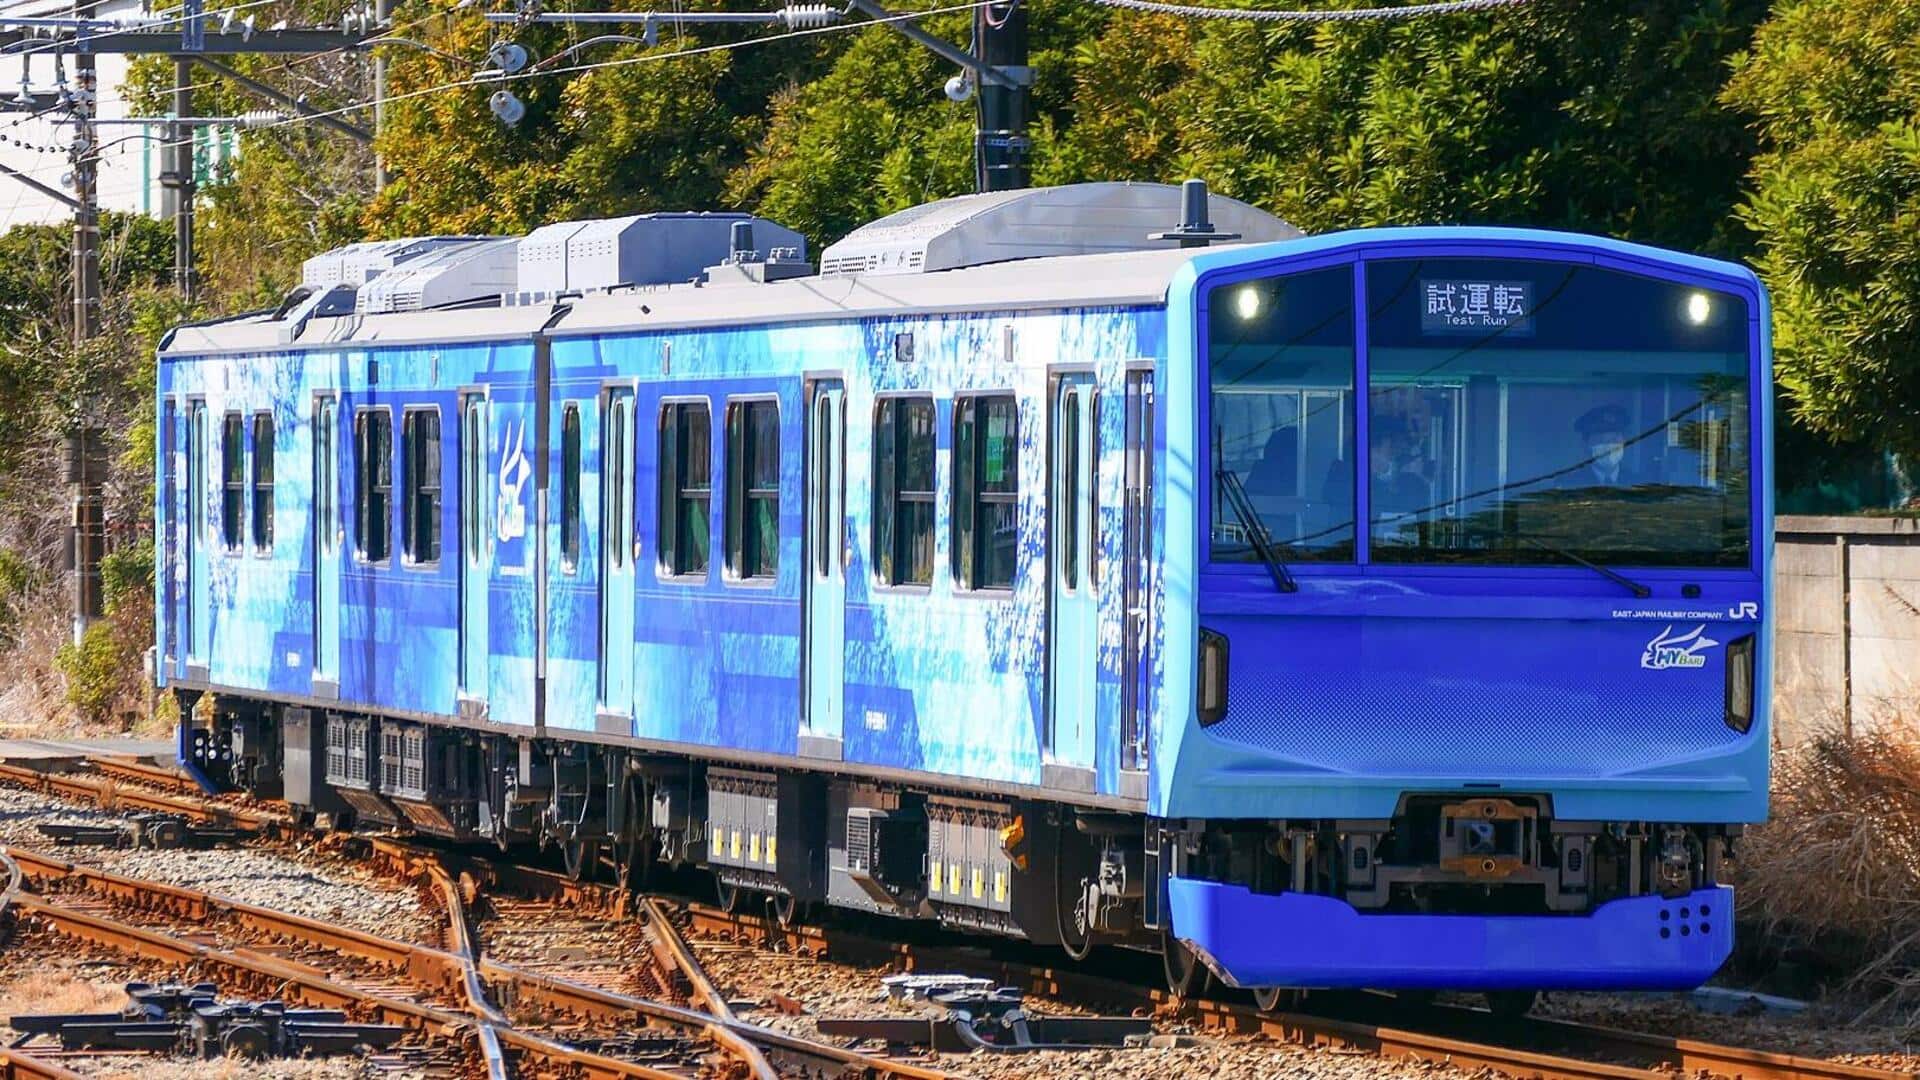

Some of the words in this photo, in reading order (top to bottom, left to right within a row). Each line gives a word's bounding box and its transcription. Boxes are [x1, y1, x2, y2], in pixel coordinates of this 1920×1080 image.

[1427, 283, 1524, 315] 試運転
[1445, 314, 1475, 325] Test
[1483, 315, 1507, 325] Run
[1612, 610, 1633, 618] EAST
[1633, 610, 1657, 618] JAPAN
[1687, 611, 1724, 619] COMPANY
[1729, 602, 1758, 619] JR
